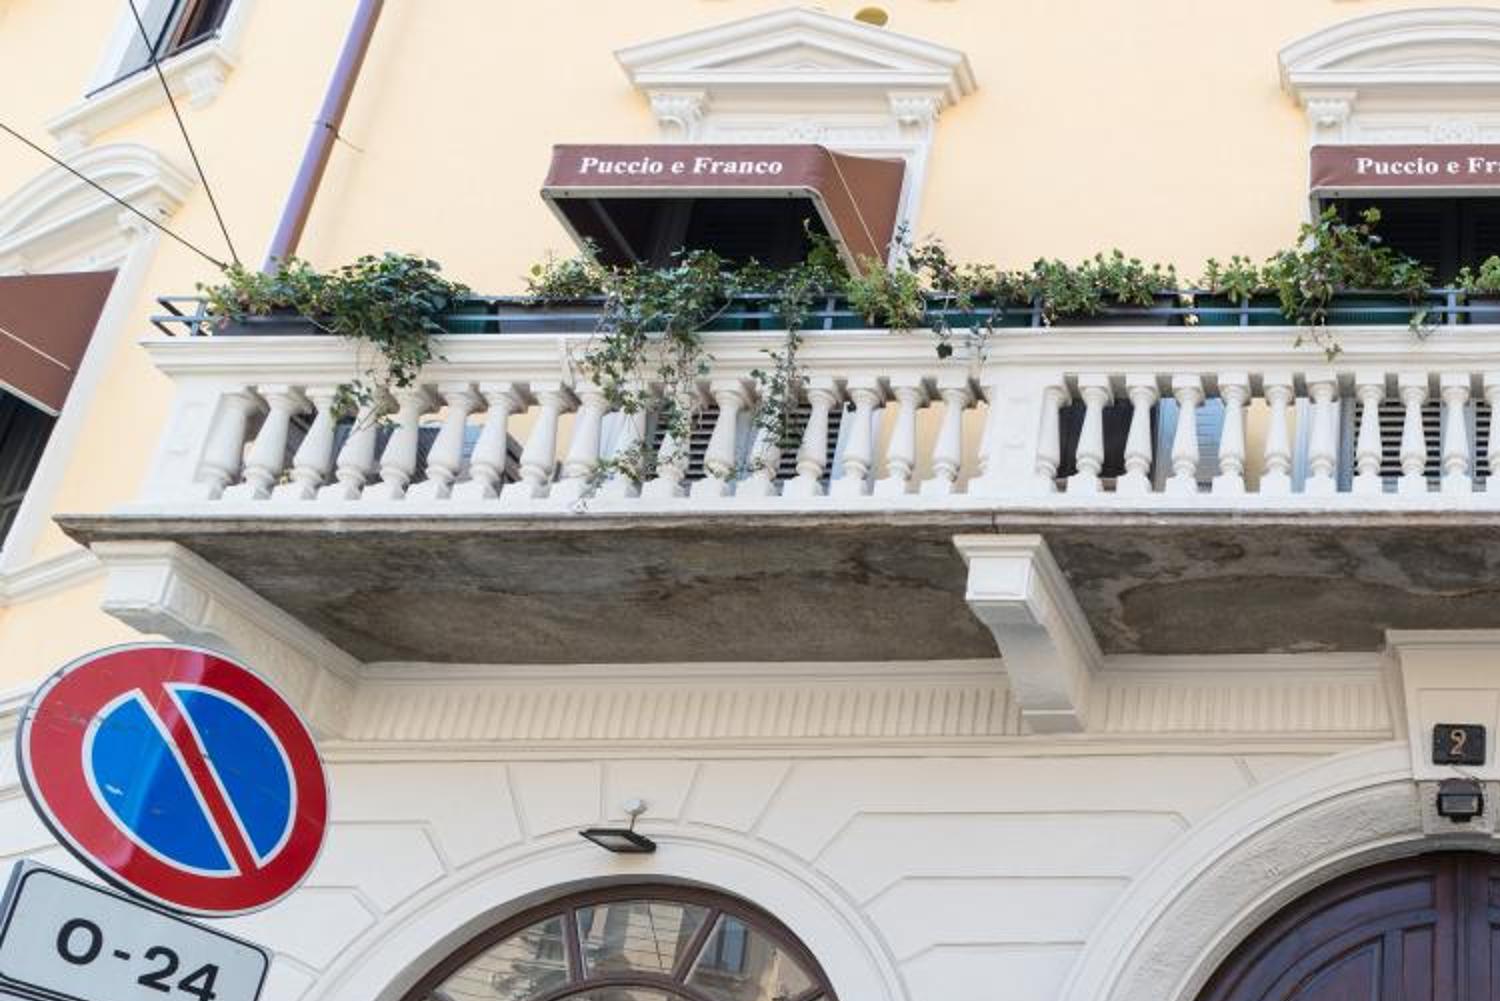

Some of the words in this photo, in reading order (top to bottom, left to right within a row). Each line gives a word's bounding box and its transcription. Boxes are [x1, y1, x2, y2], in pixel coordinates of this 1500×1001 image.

[579, 157, 663, 174] Puccio
[671, 161, 685, 174] e
[693, 157, 784, 174] Franco
[1356, 157, 1439, 176] Puccio
[1446, 160, 1460, 174] e
[1449, 729, 1467, 755] 2
